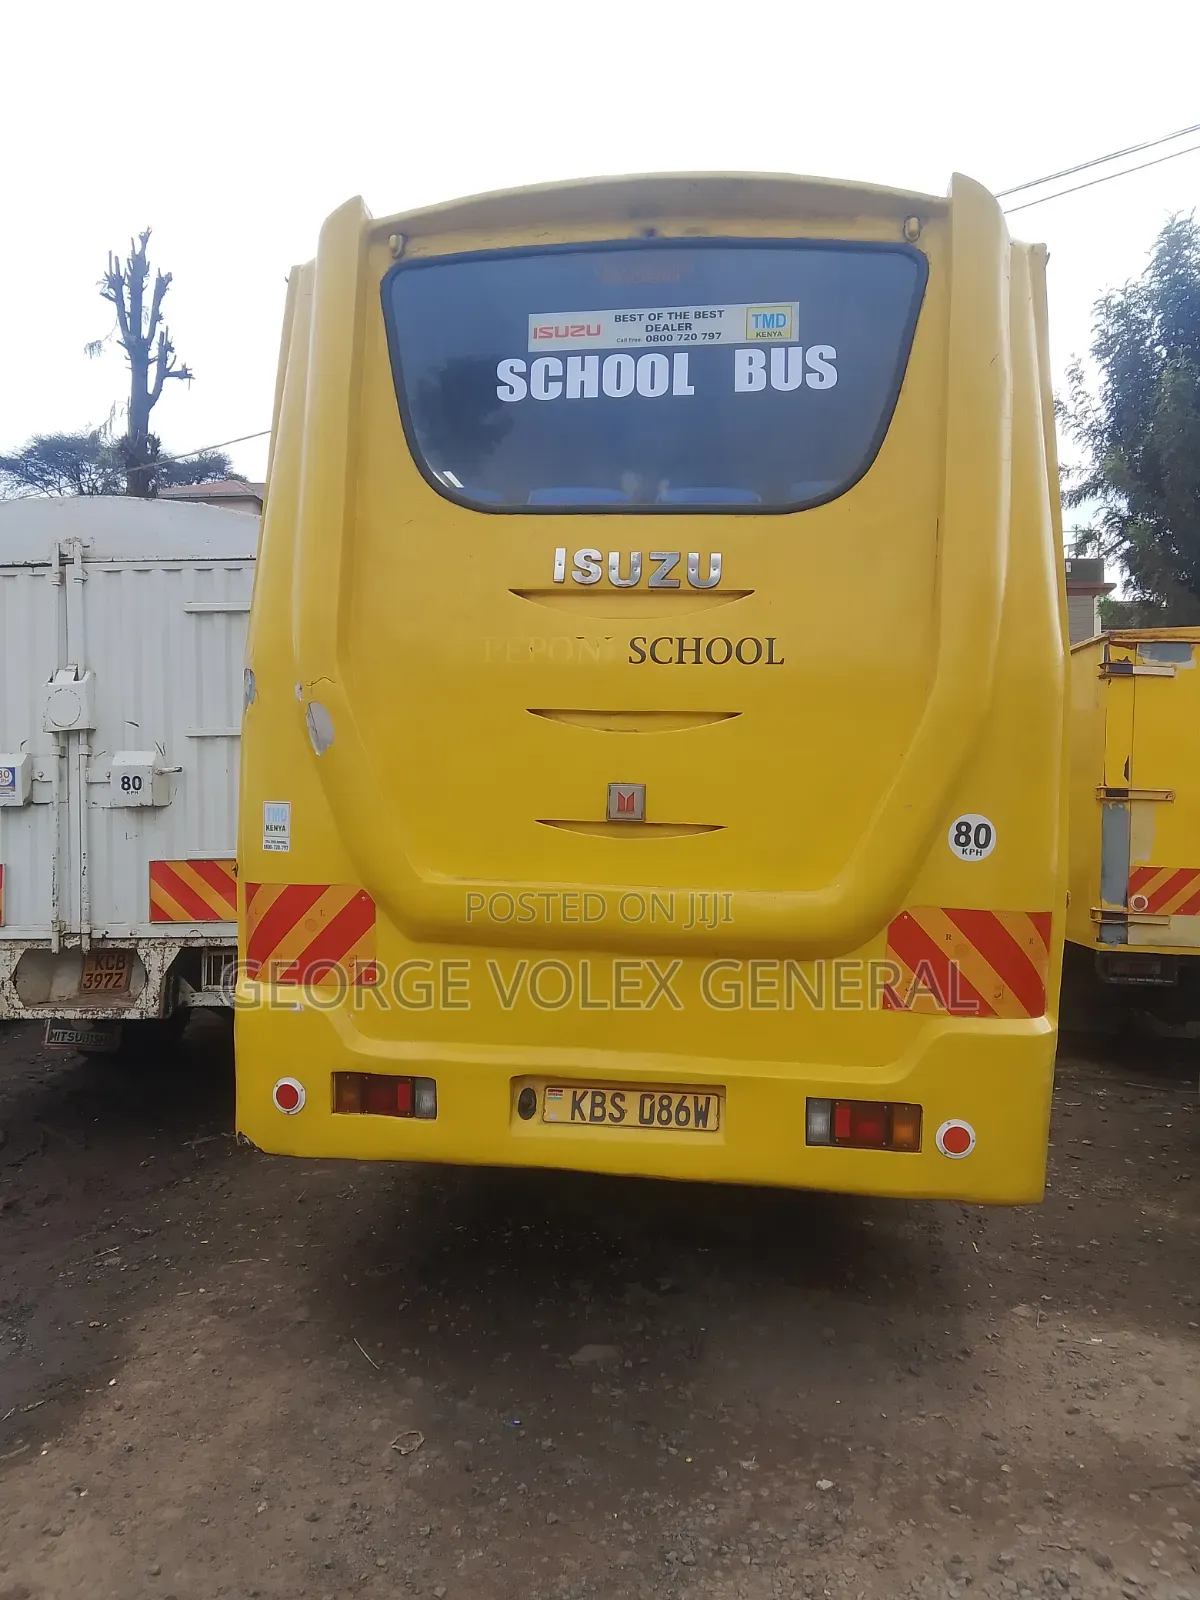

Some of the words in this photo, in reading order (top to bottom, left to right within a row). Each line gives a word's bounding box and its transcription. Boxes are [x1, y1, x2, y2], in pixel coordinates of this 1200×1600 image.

[614, 314, 645, 323] BEST
[647, 312, 664, 321] OF
[667, 311, 690, 320] THE
[694, 309, 725, 319] BEST
[751, 312, 787, 329] TMD
[533, 324, 601, 340] ISUZU
[645, 322, 692, 333] DEALER
[755, 330, 783, 338] KENYA
[645, 335, 673, 343] 0800
[677, 333, 697, 342] 720
[701, 332, 722, 340] 797
[496, 352, 695, 402] SCHOOL
[734, 345, 837, 392] BUS
[553, 547, 723, 589] ISUZU
[628, 637, 785, 665] SCHOOL
[121, 775, 143, 791] 80
[265, 824, 286, 832] KENYA
[954, 821, 992, 849] 80
[961, 848, 983, 857] KPH
[95, 955, 125, 971] KCB
[83, 972, 123, 989] 397Z
[50, 1031, 112, 1045] MITSUBISH
[570, 1090, 627, 1123] KBS
[638, 1093, 712, 1129] 086W
